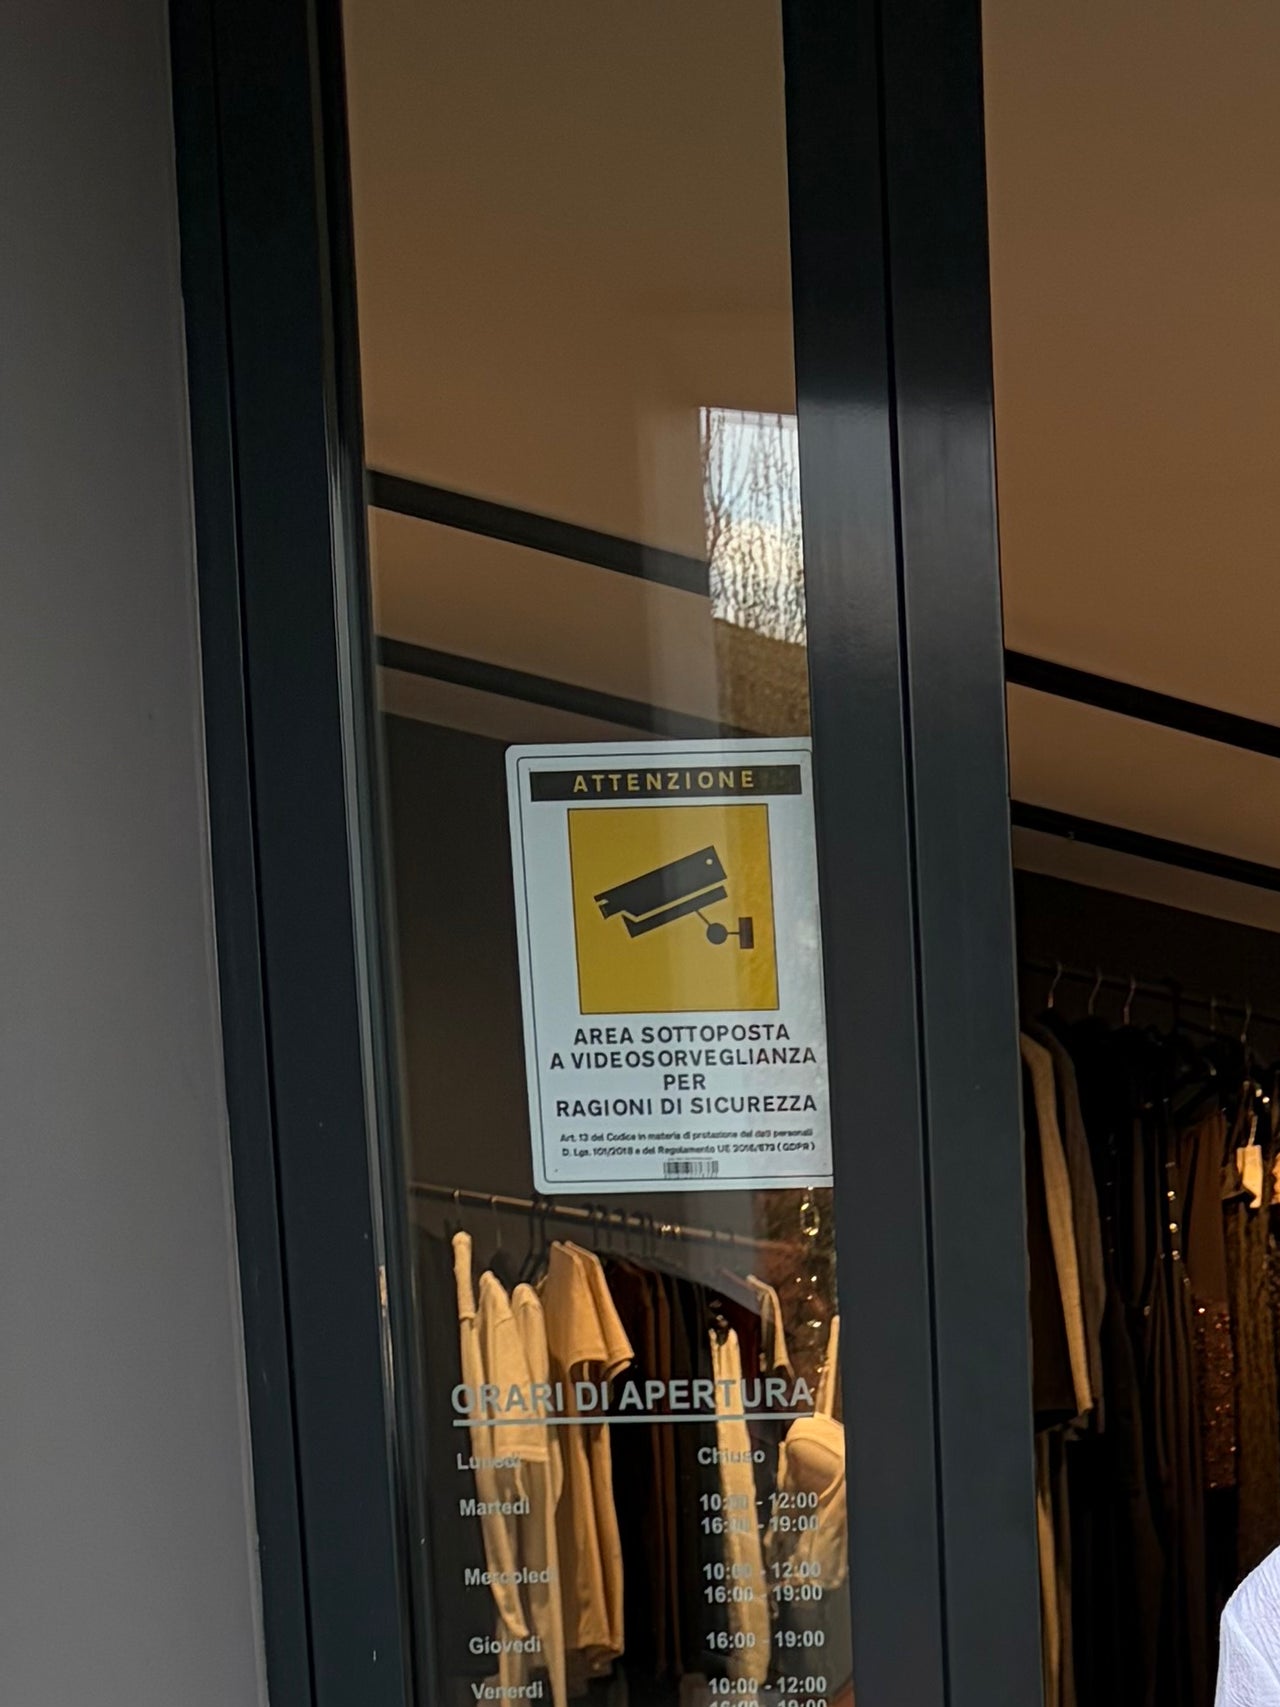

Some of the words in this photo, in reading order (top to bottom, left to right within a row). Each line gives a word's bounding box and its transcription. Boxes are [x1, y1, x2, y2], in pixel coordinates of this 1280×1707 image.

[573, 770, 755, 793] ATTENZIONE
[574, 1027, 634, 1045] AREA
[641, 1024, 790, 1044] SOTTOPOSTA
[550, 1052, 565, 1070] A
[571, 1047, 817, 1069] VIDEOSORVEGLIANZA
[663, 1073, 706, 1091] PER
[556, 1098, 652, 1117] RAGIONI
[661, 1098, 682, 1115] DI
[690, 1095, 817, 1114] SICUREZZA
[451, 1382, 565, 1414] ORARI
[576, 1380, 609, 1412] DI
[618, 1377, 815, 1411] APERTURA
[697, 1446, 766, 1465] Chiuso
[768, 1491, 819, 1509] 12:00
[769, 1514, 820, 1532] 19:00
[703, 1562, 752, 1581] 10:00
[771, 1561, 821, 1579] 12:00
[704, 1585, 753, 1604] 16:00
[772, 1584, 823, 1602] 19:00
[706, 1631, 756, 1650] 16:00
[774, 1630, 825, 1648] 19:00
[709, 1677, 759, 1695] 10:00
[776, 1675, 827, 1694] 12:00
